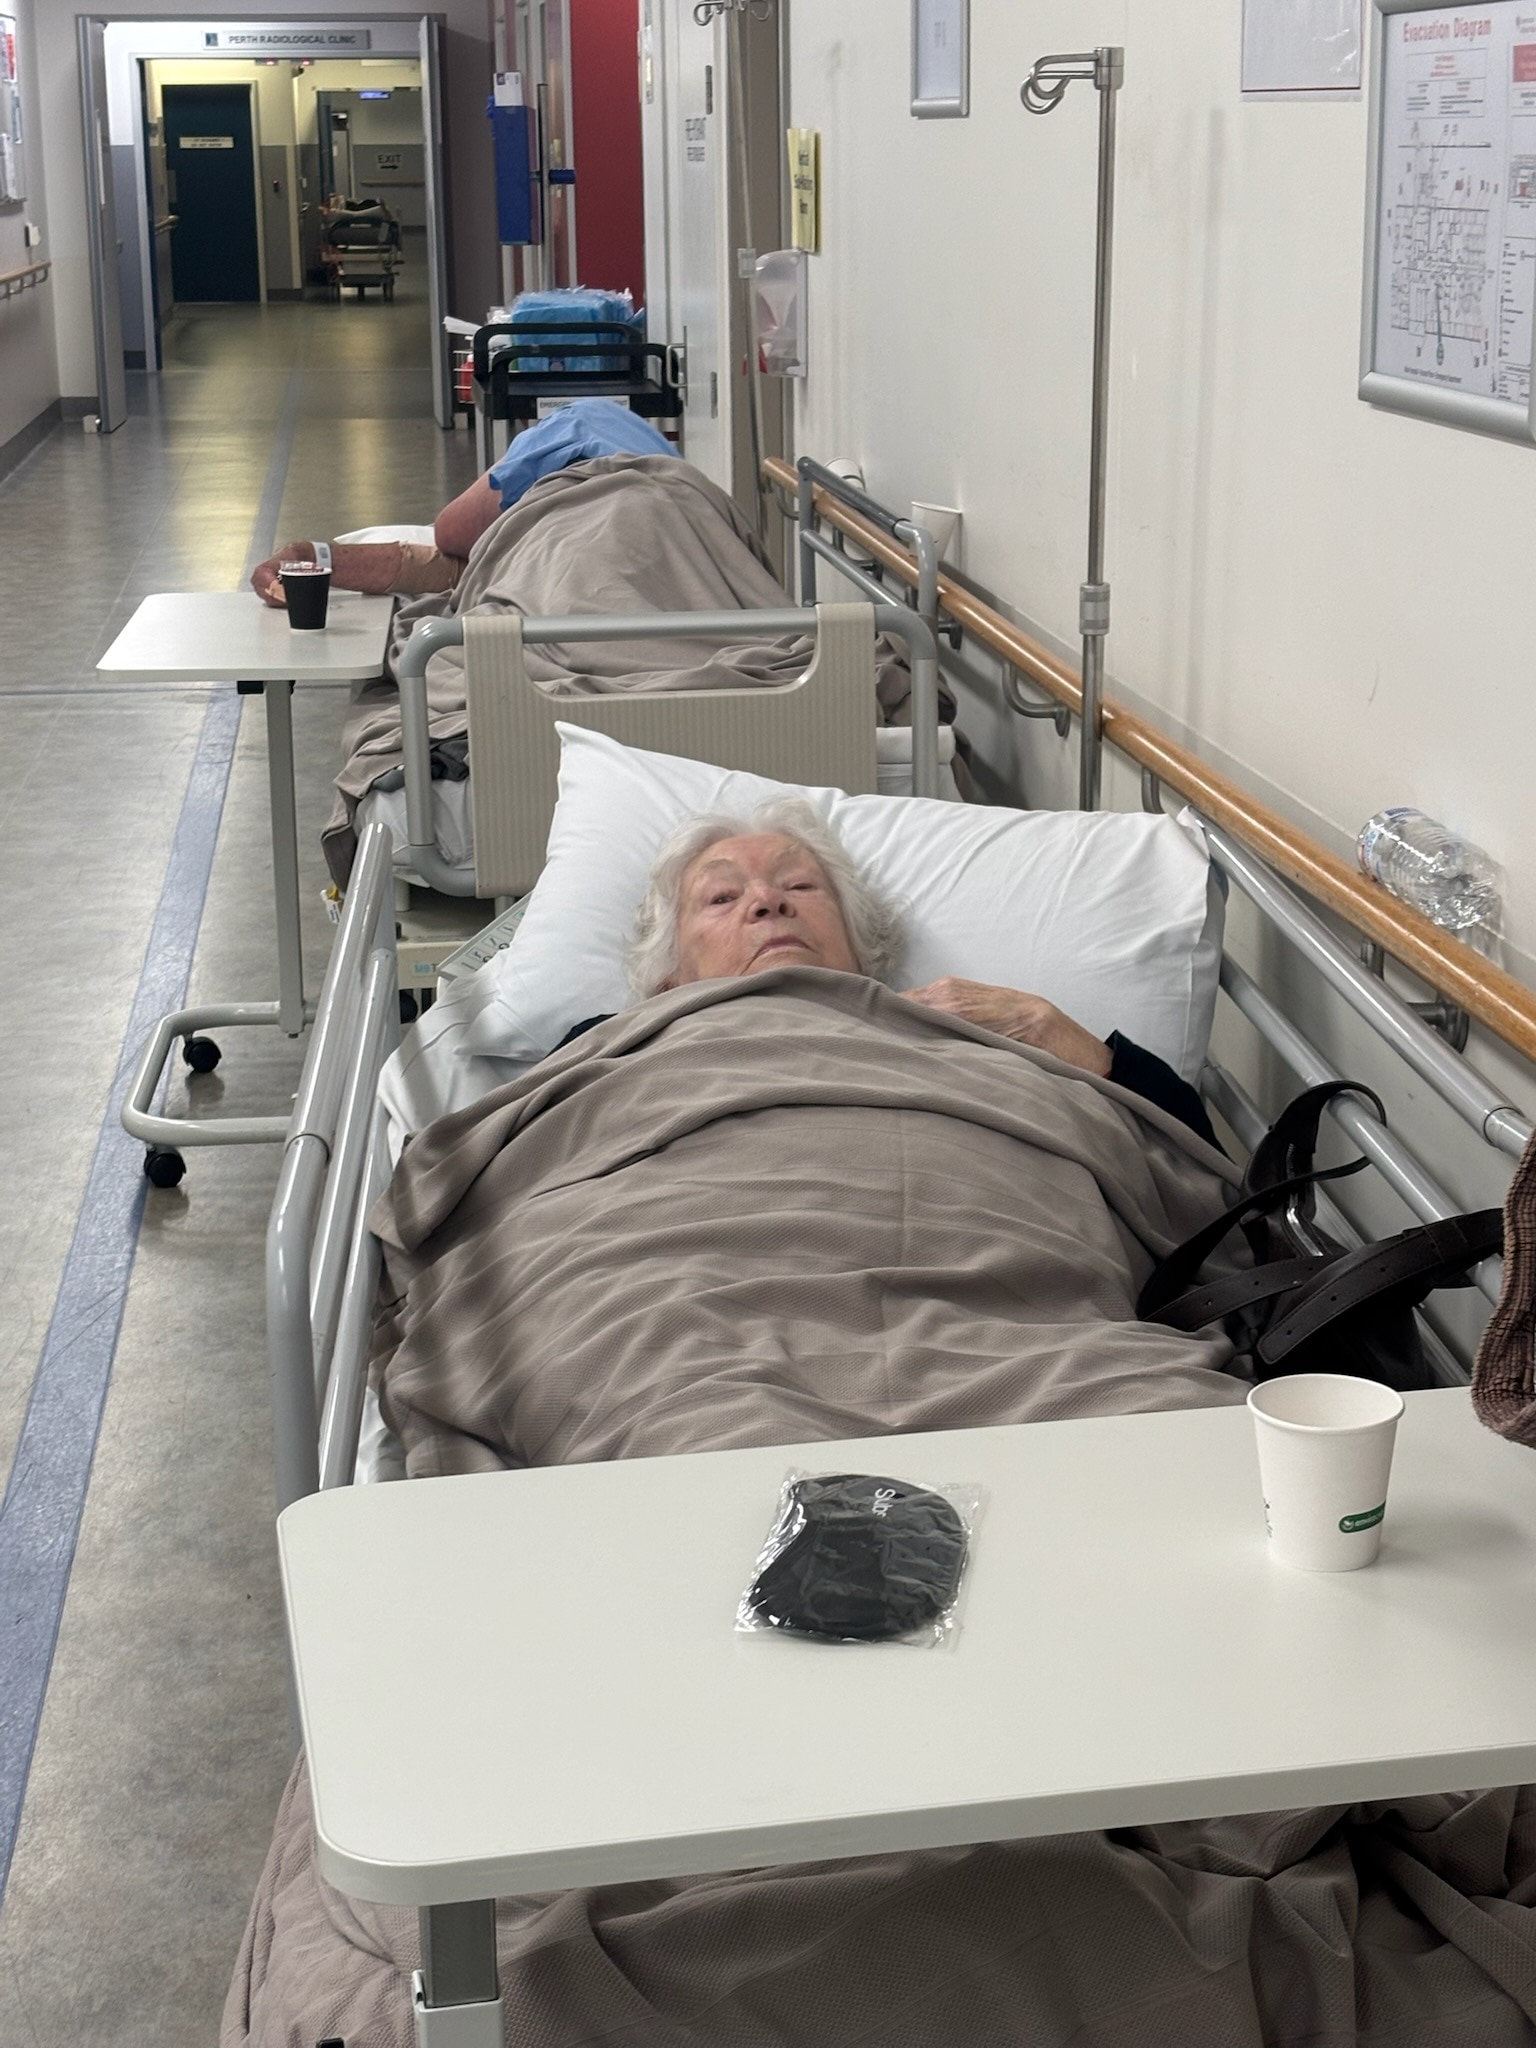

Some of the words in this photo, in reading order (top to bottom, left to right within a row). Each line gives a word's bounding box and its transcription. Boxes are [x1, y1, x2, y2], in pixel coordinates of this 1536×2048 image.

[1403, 20, 1450, 42] Evacuation
[1453, 17, 1492, 41] Diagram
[229, 35, 257, 44] PERTH
[259, 35, 325, 44] RADIOLOGICAL
[327, 35, 356, 44] CLINIC
[377, 154, 401, 163] EXIT
